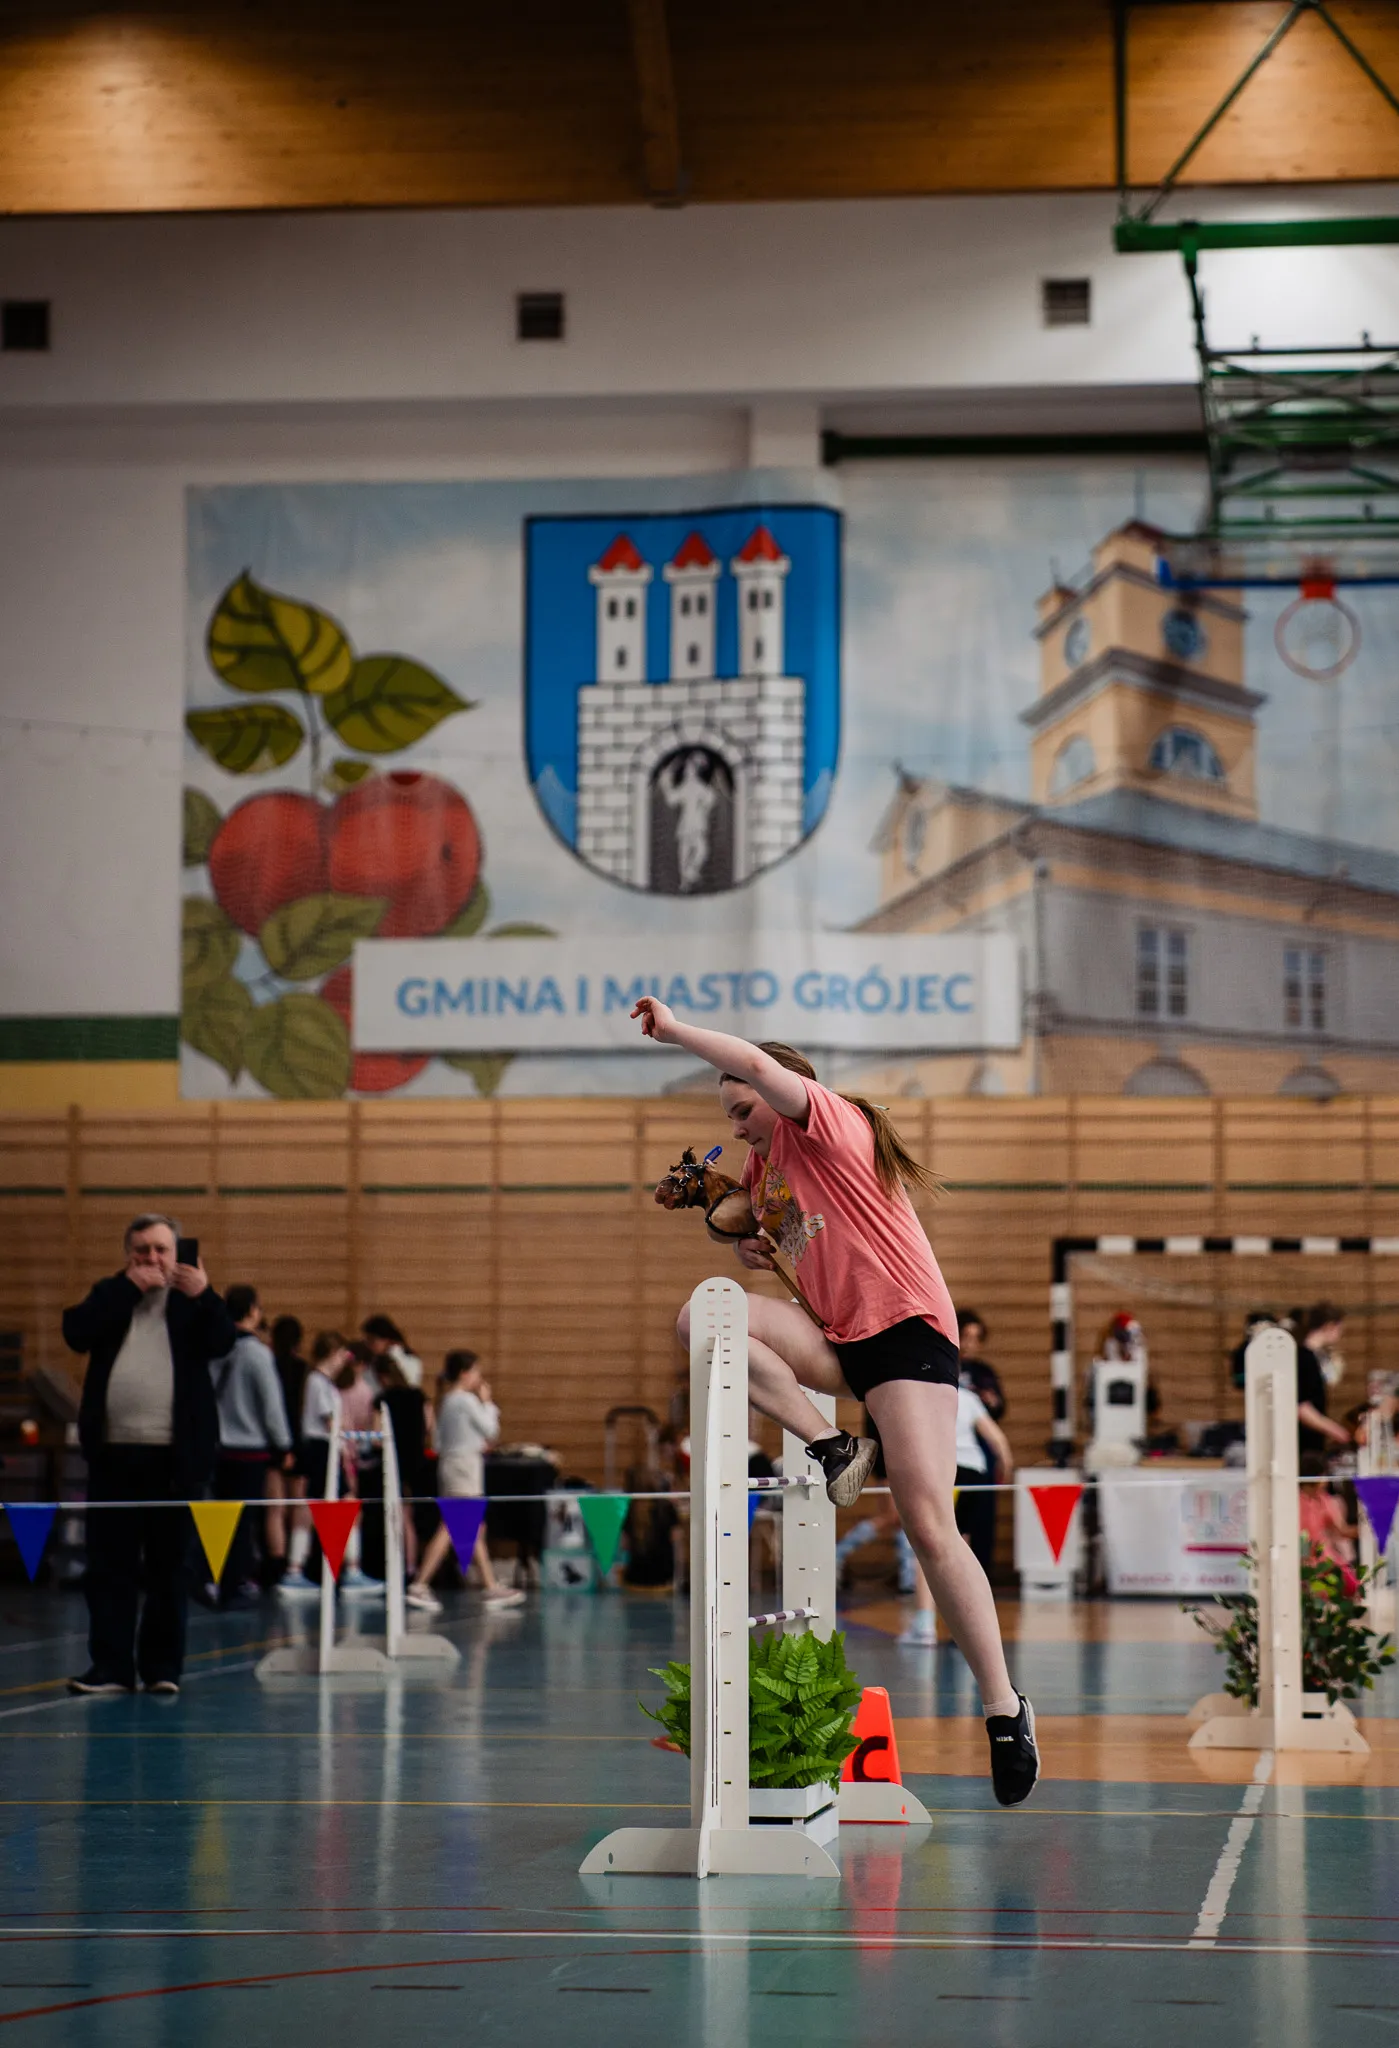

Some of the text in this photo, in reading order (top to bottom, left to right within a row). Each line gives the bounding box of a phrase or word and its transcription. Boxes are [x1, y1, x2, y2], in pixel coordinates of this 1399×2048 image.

[396, 963, 973, 1017] GMINA I MIASTO GRÓJEC
